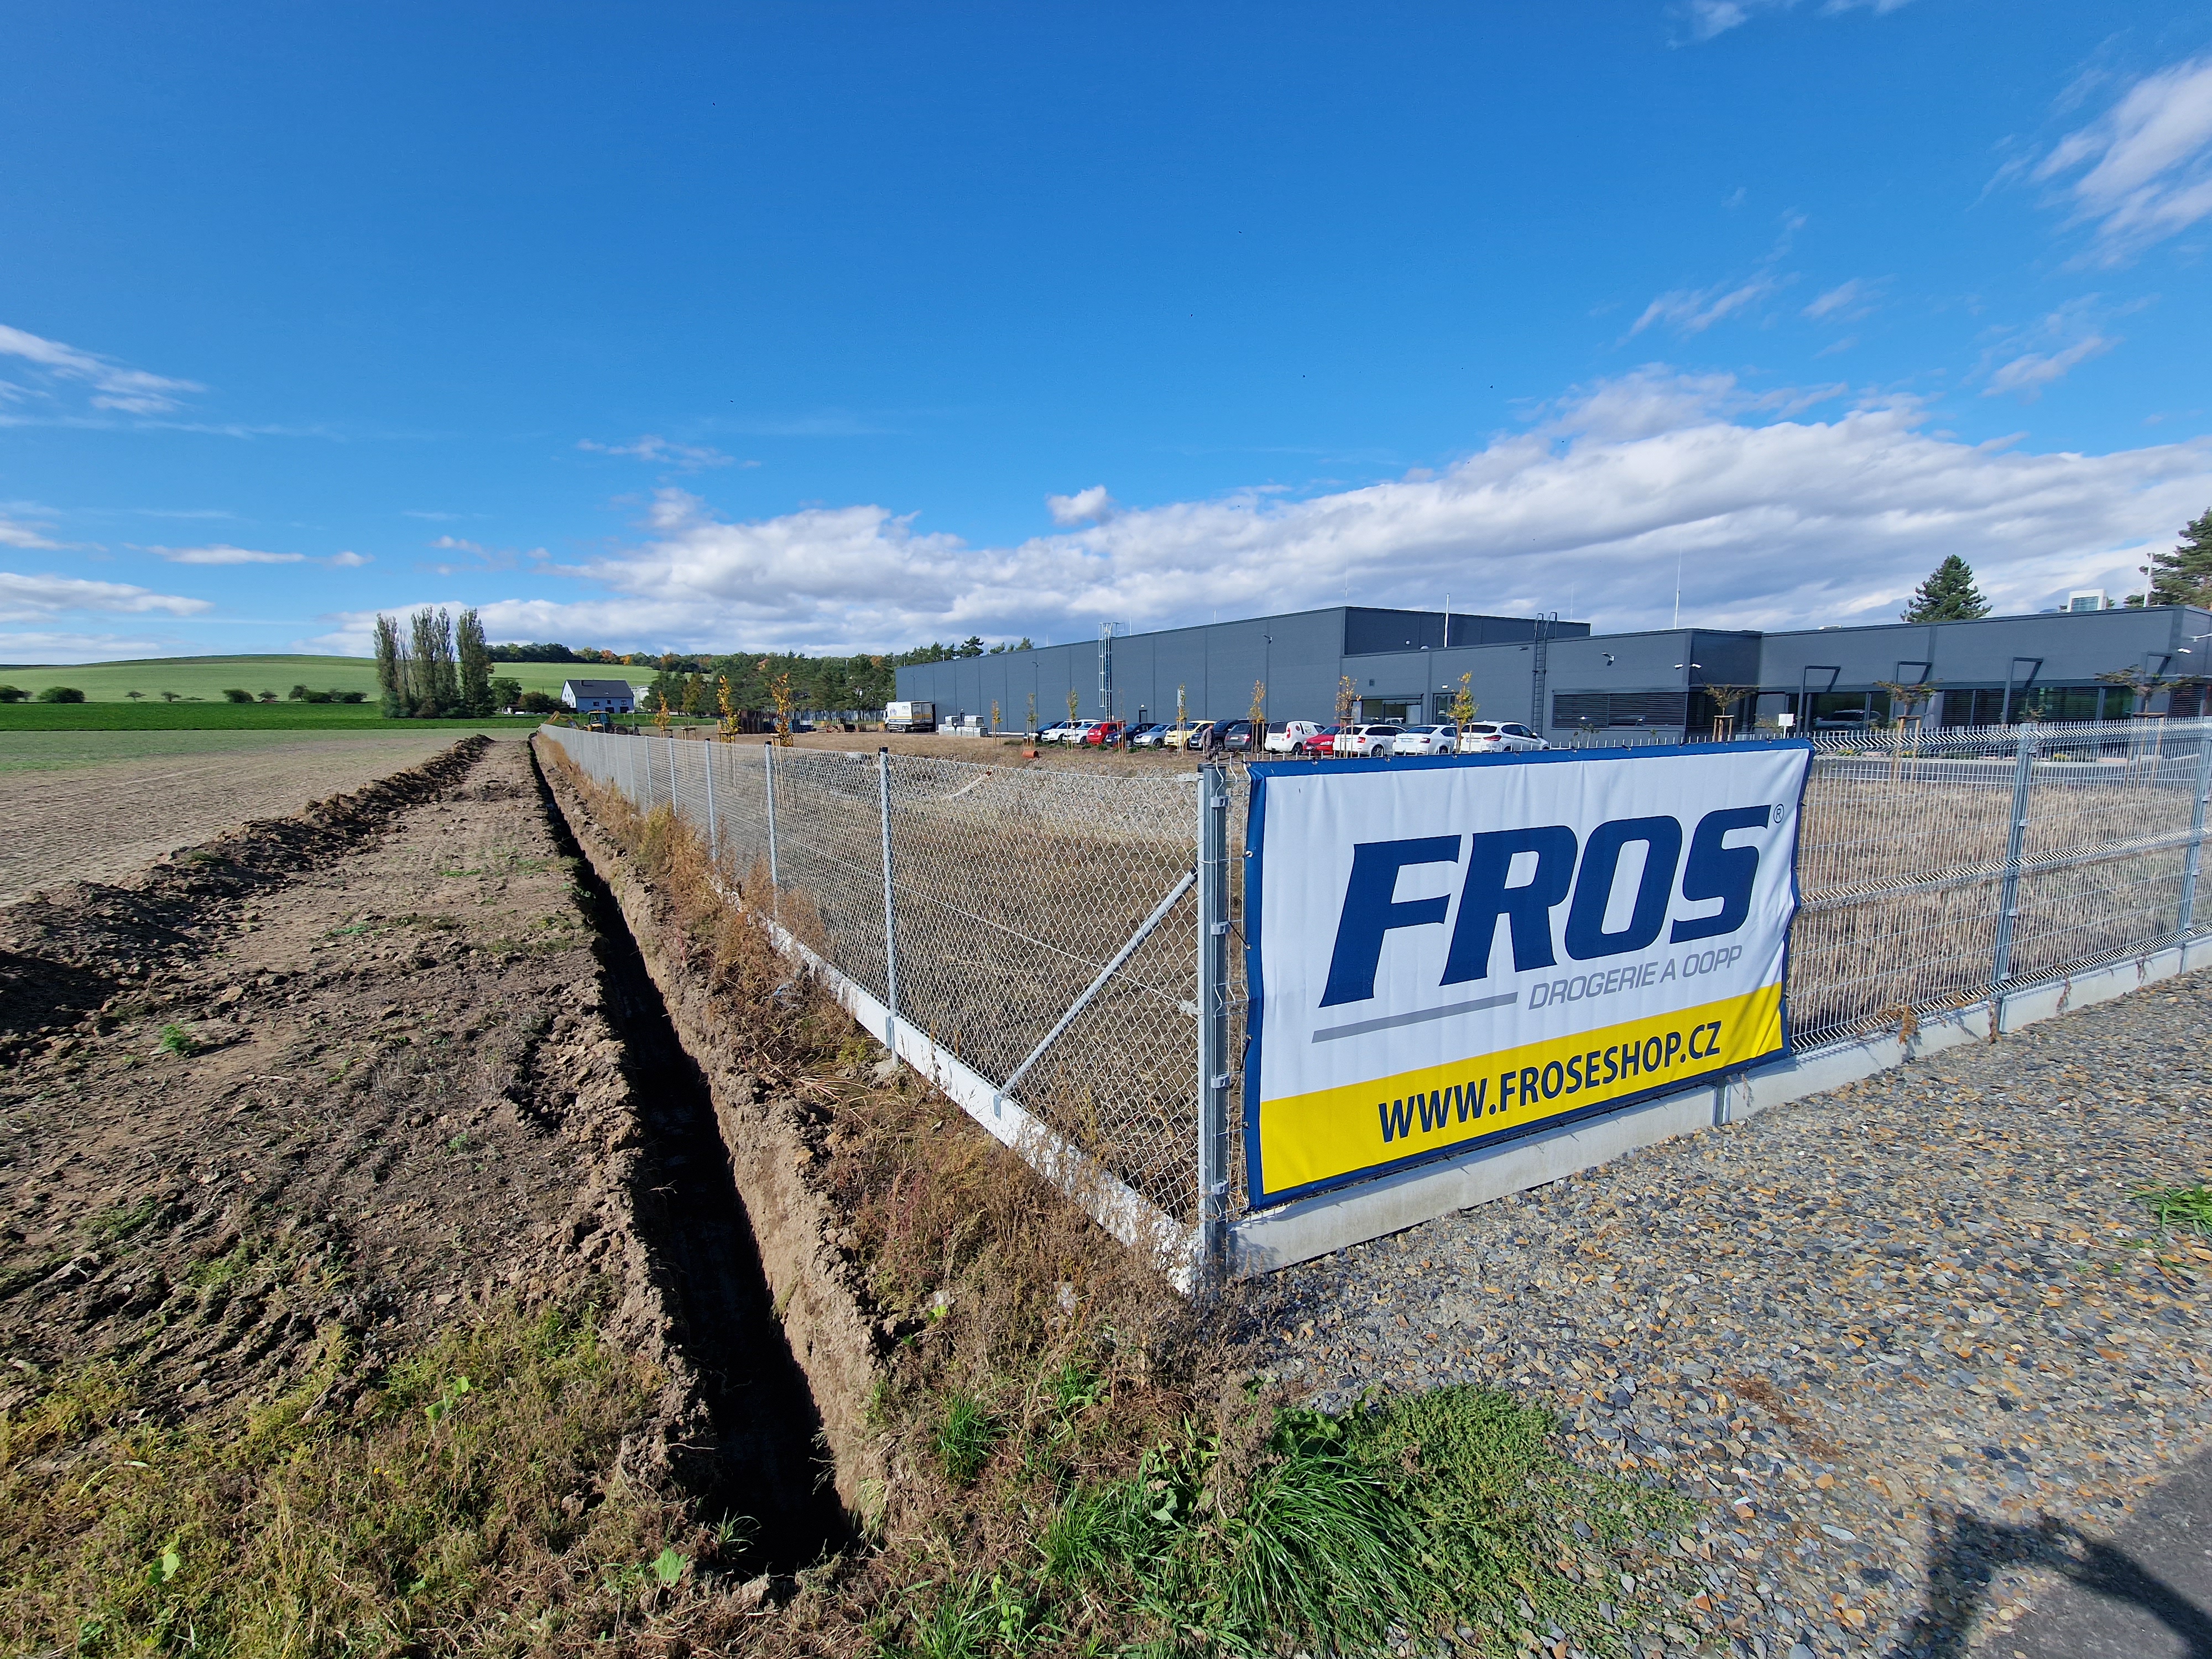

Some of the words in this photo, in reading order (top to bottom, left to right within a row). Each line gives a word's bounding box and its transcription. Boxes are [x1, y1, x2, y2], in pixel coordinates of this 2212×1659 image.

[1318, 804, 1771, 1009] FROS
[1528, 961, 1658, 1010] DROGERIE
[1660, 958, 1676, 983] A
[1682, 945, 1743, 978] OOPP
[1378, 1020, 1722, 1143] WWW.FROSESHOP.CZ
